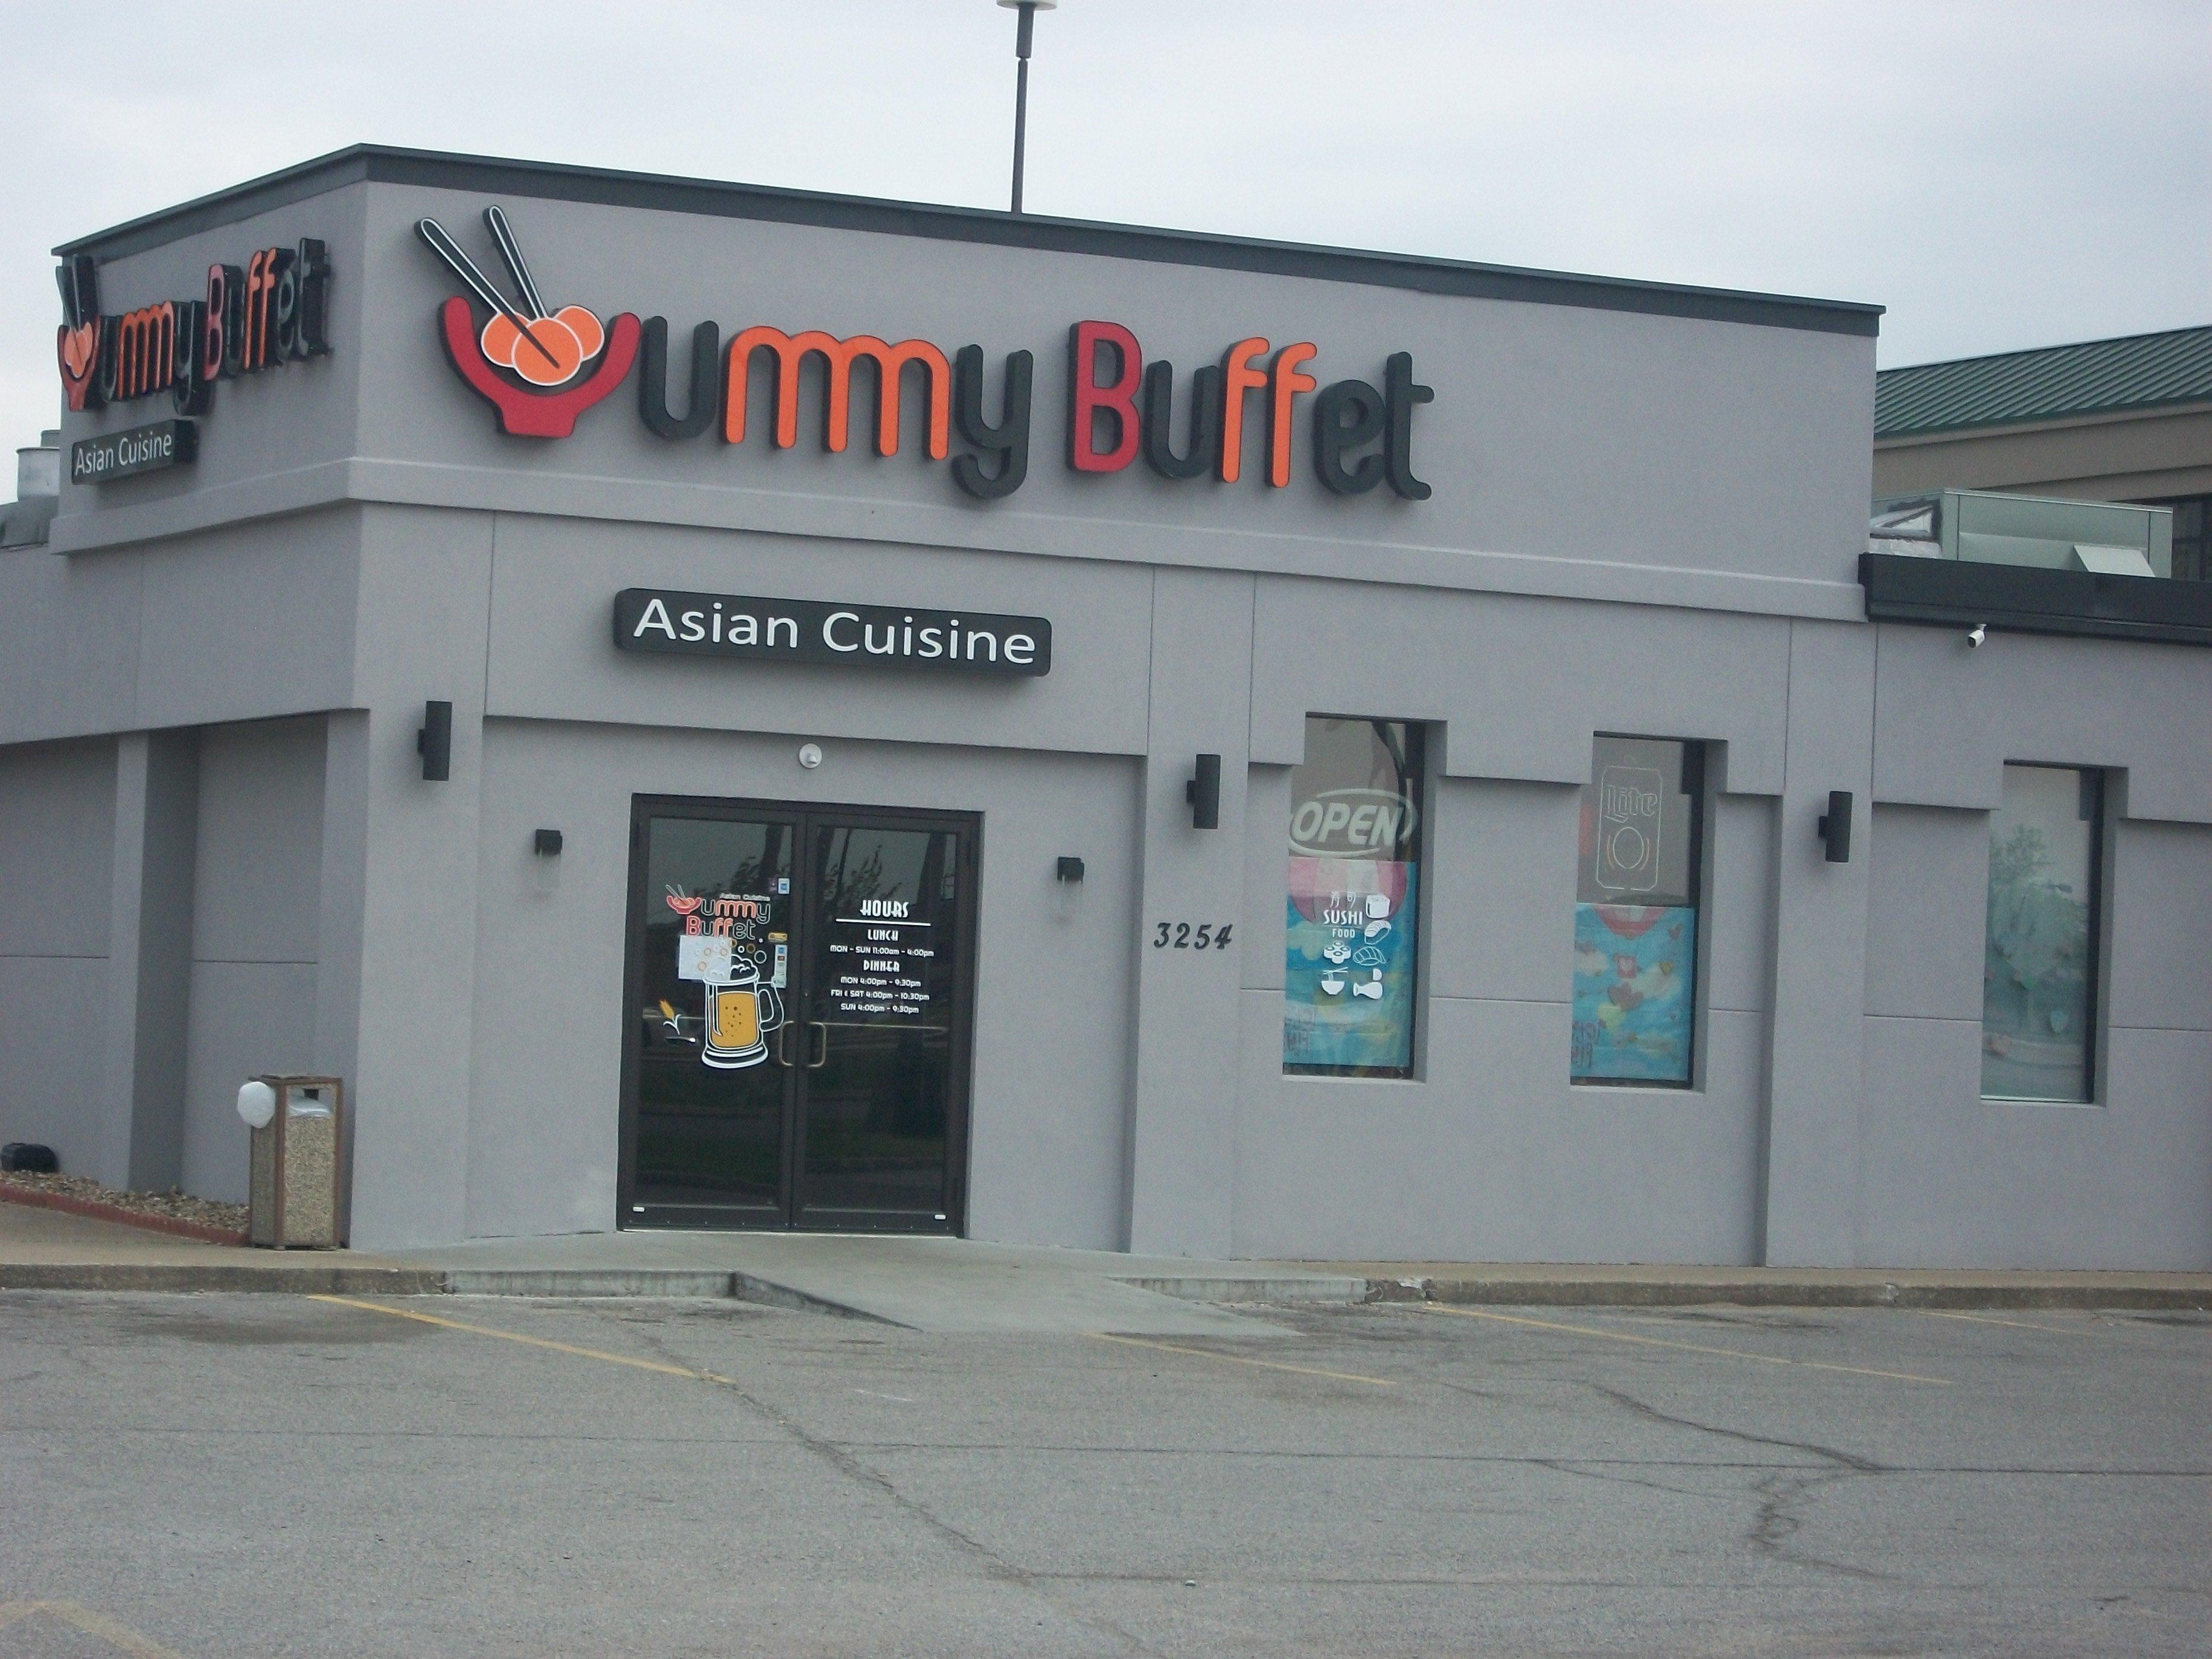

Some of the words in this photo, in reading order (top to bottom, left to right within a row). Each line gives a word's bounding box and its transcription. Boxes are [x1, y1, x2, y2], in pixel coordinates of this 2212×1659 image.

[204, 238, 332, 382] Buffet
[1066, 319, 1435, 500] Buffet
[75, 443, 113, 476] Asian
[119, 430, 173, 466] Cuisine
[633, 598, 798, 648] Asian
[822, 612, 1035, 664] Cuisine
[1605, 784, 1657, 823] Lite
[1291, 801, 1405, 846] OPEN
[860, 900, 910, 918] HOURS
[1323, 909, 1363, 925] SUSHI
[686, 915, 756, 940] Buffet
[867, 929, 899, 941] LUNCH
[1154, 922, 1233, 950] 3254
[1331, 929, 1356, 938] FOOD
[855, 945, 871, 954] SUN
[907, 948, 935, 958] 4:00pm
[863, 959, 900, 973] DINNER
[860, 977, 887, 986] 4:00pm
[849, 989, 865, 998] SAT
[866, 991, 893, 1000] 4:00pm
[858, 1003, 885, 1012] 4:00pm
